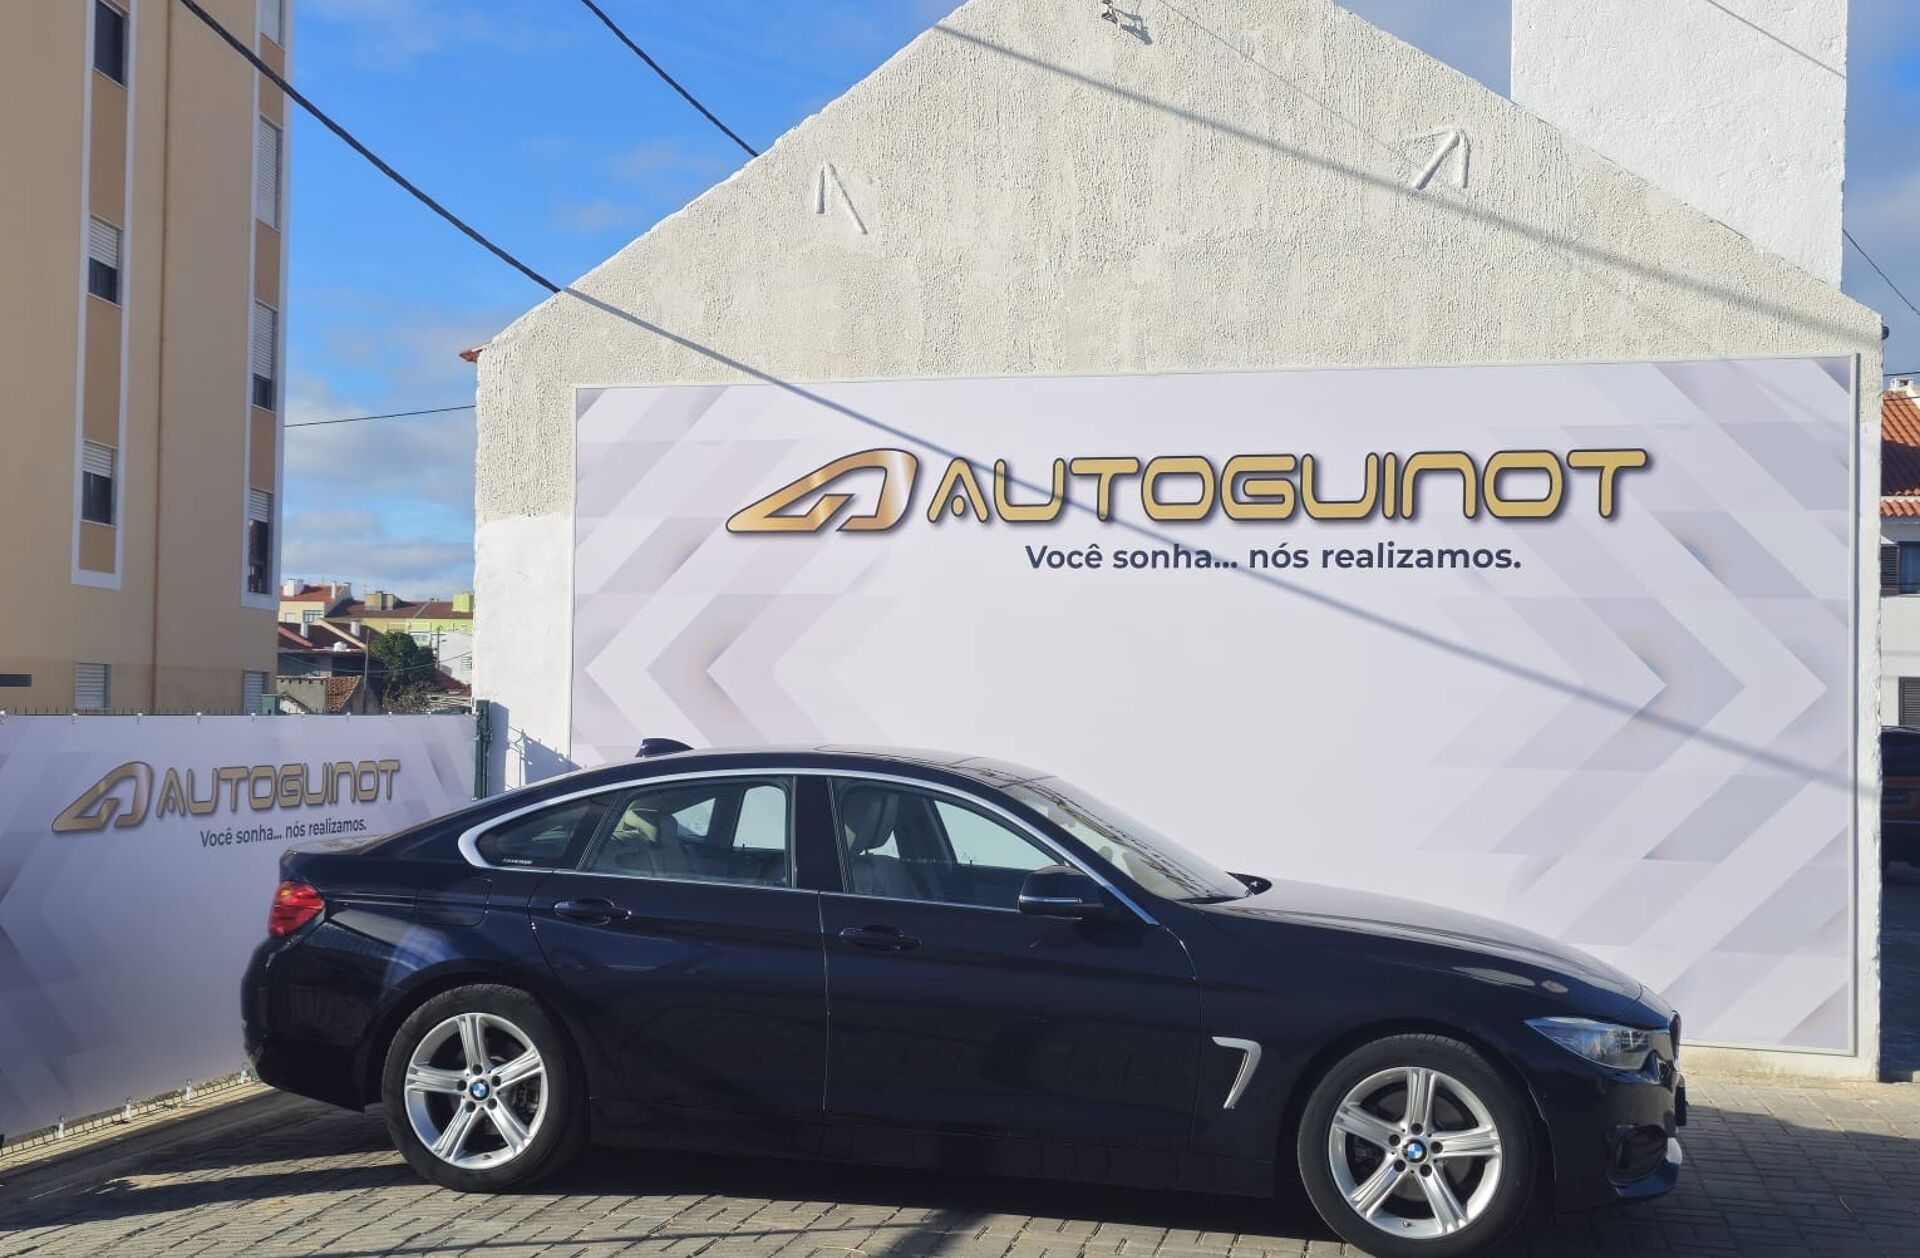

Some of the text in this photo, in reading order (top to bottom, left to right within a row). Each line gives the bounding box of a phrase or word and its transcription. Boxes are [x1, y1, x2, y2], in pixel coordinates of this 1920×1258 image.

[927, 448, 1648, 523] AUTOGUINOT
[1025, 541, 1521, 569] Você sonha... nós realizamos.
[156, 759, 401, 817] AUTOGUINOT
[200, 817, 367, 848] Você sonha... nós realizamos.
